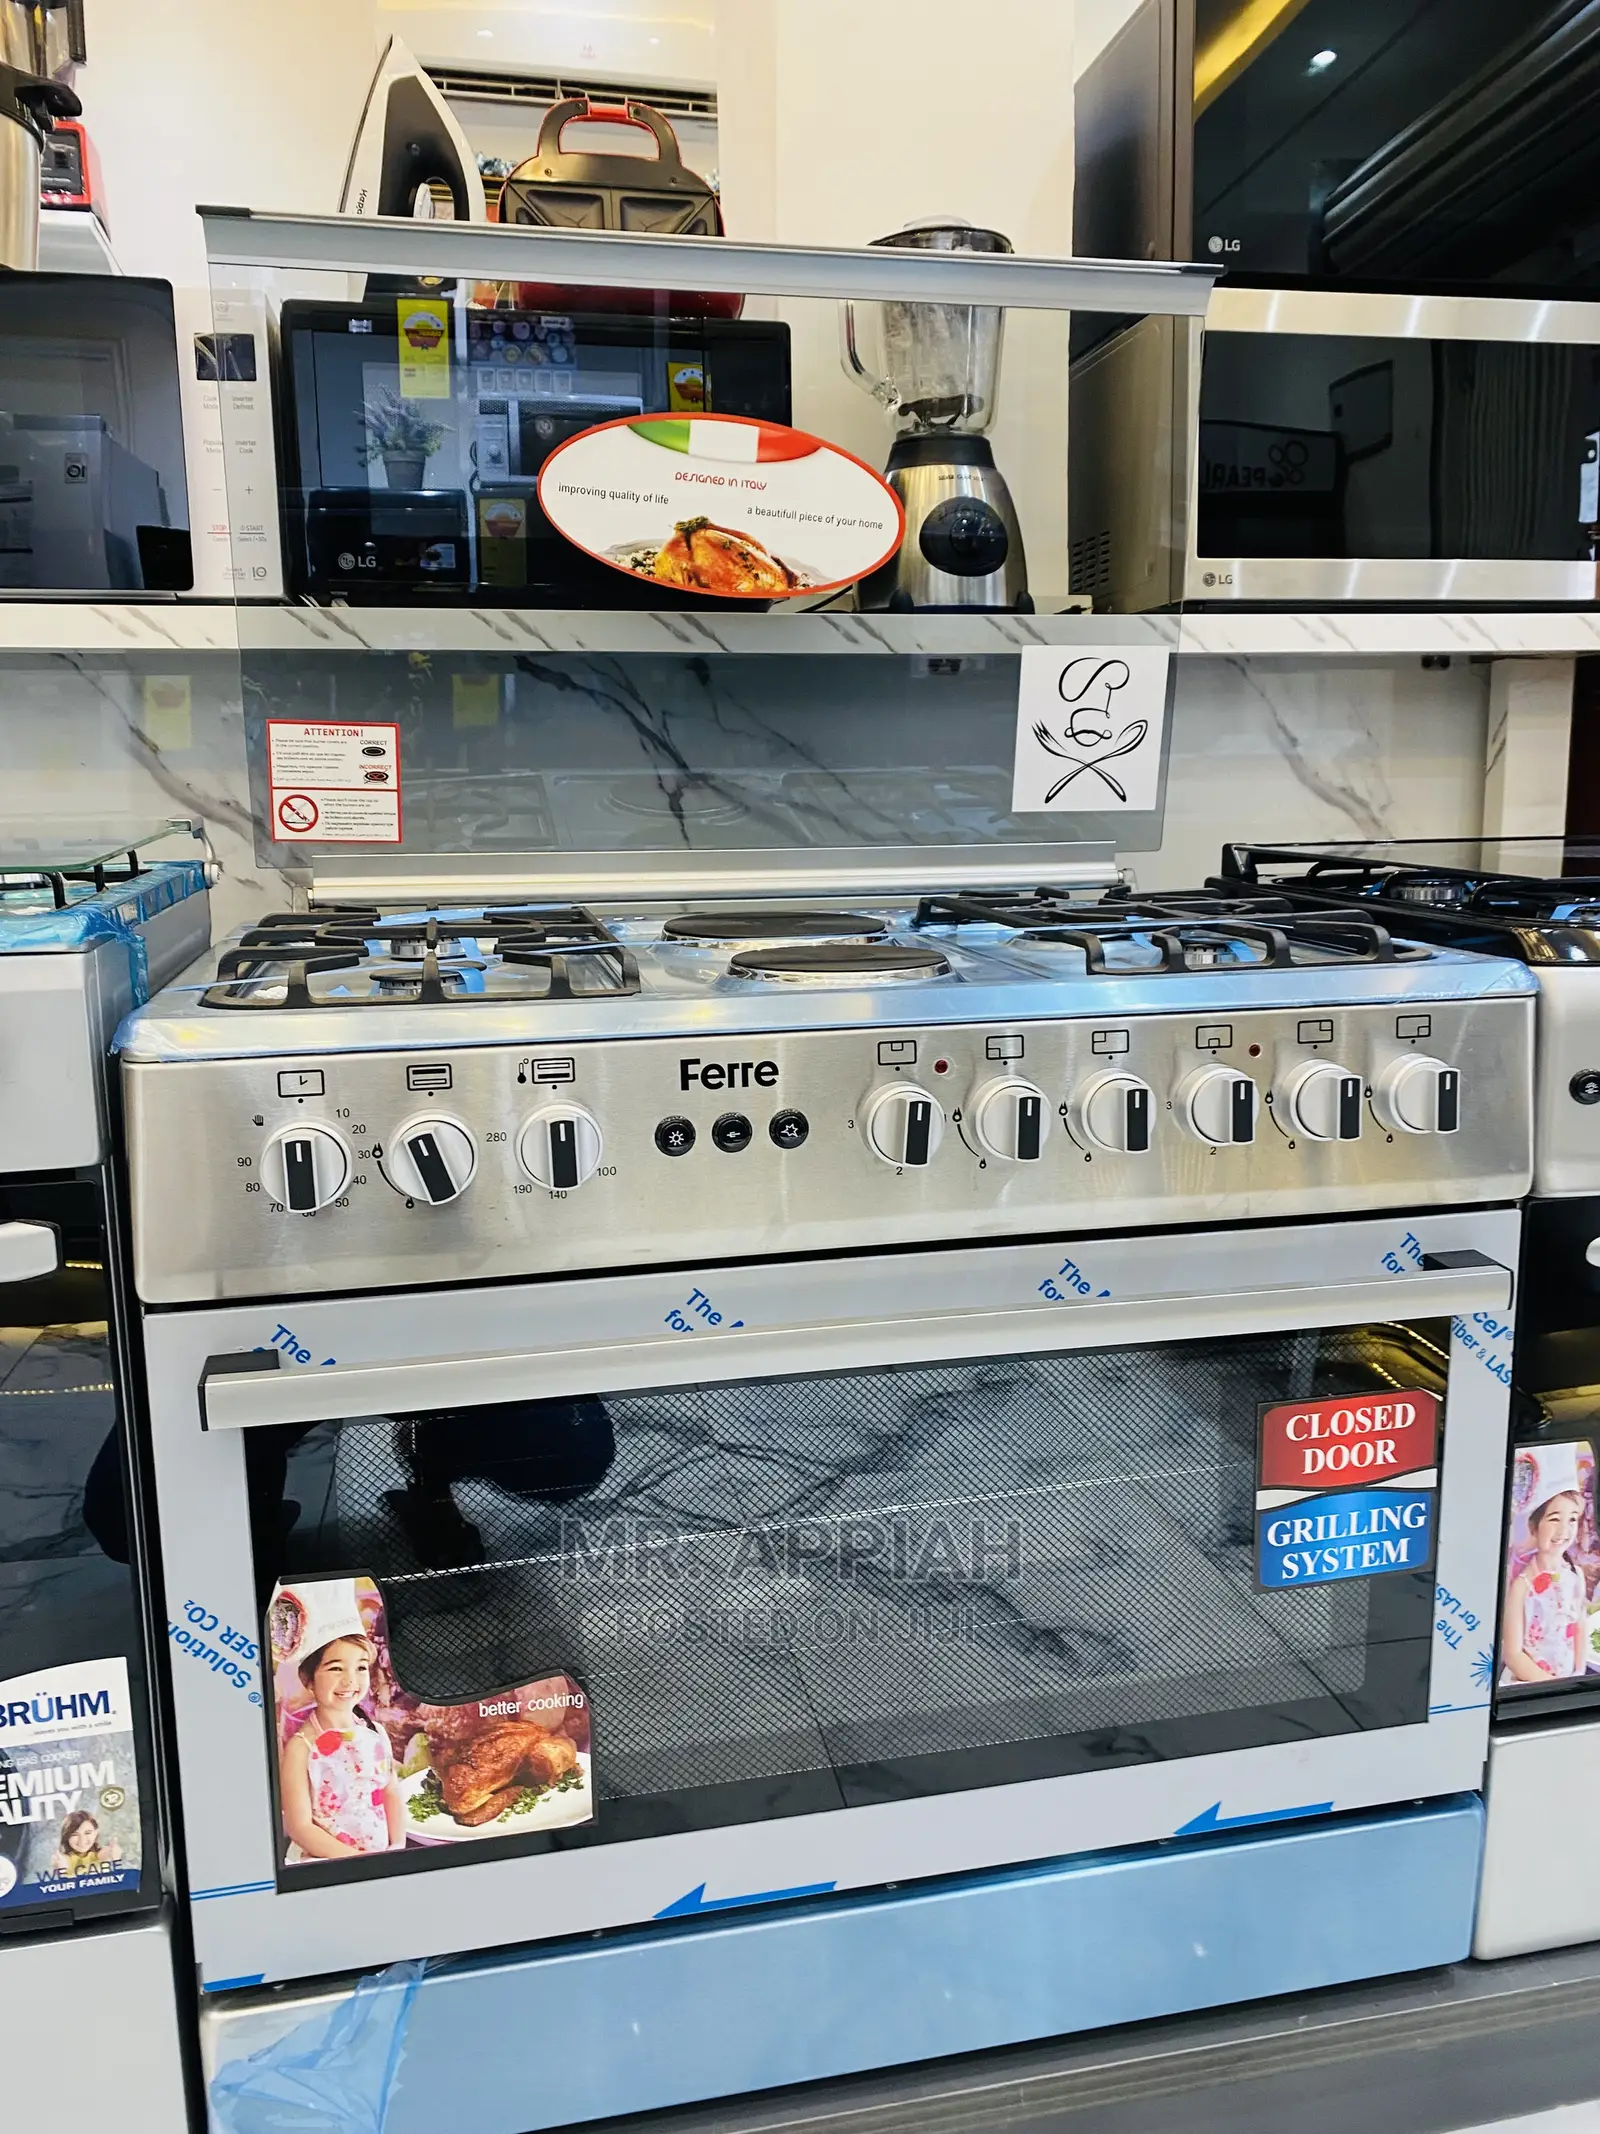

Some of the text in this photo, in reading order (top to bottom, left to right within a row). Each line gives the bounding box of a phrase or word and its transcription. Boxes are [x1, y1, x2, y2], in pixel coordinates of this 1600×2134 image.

[674, 471, 768, 491] DESIGNED IN ITALY
[558, 481, 669, 505] improving quality of life
[747, 505, 884, 530] a beautifull piece of your home
[357, 556, 377, 568] LG
[1218, 574, 1233, 585] LG
[303, 727, 365, 738] ATTENTION!
[679, 1058, 779, 1091] Ferre
[335, 1108, 350, 1118] 10
[1166, 1101, 1172, 1110] 3
[352, 1124, 366, 1134] 20
[847, 1119, 854, 1129] 3
[486, 1132, 507, 1142] 280
[358, 1150, 370, 1160] 30
[1210, 1146, 1216, 1156] 2
[237, 1156, 252, 1167] 90
[596, 1166, 617, 1177] 100
[895, 1166, 902, 1176] 2
[245, 1182, 260, 1192] 80
[352, 1175, 367, 1185] 40
[512, 1184, 533, 1194] 190
[335, 1198, 350, 1208] 50
[548, 1190, 568, 1200] 140
[269, 1202, 284, 1212] 70
[1381, 1251, 1406, 1274] for
[1058, 1257, 1091, 1295] The
[1037, 1278, 1065, 1301] for
[686, 1287, 723, 1326] The
[664, 1309, 694, 1333] for
[270, 1323, 311, 1364] The
[1476, 1348, 1486, 1361] &
[1485, 1354, 1513, 1389] LAS
[1285, 1402, 1416, 1442] CLOSED
[1301, 1439, 1398, 1475] DOOR
[1267, 1502, 1427, 1547] GRILLING
[1281, 1537, 1411, 1580] SYSTEM
[1435, 1582, 1481, 1632] for LAS
[1436, 1619, 1463, 1650] The
[219, 1625, 260, 1668] SER
[478, 1692, 584, 1718] better cooking
[36, 1858, 124, 1883] WE CARE
[39, 1874, 126, 1894] YOUR FAMILY
